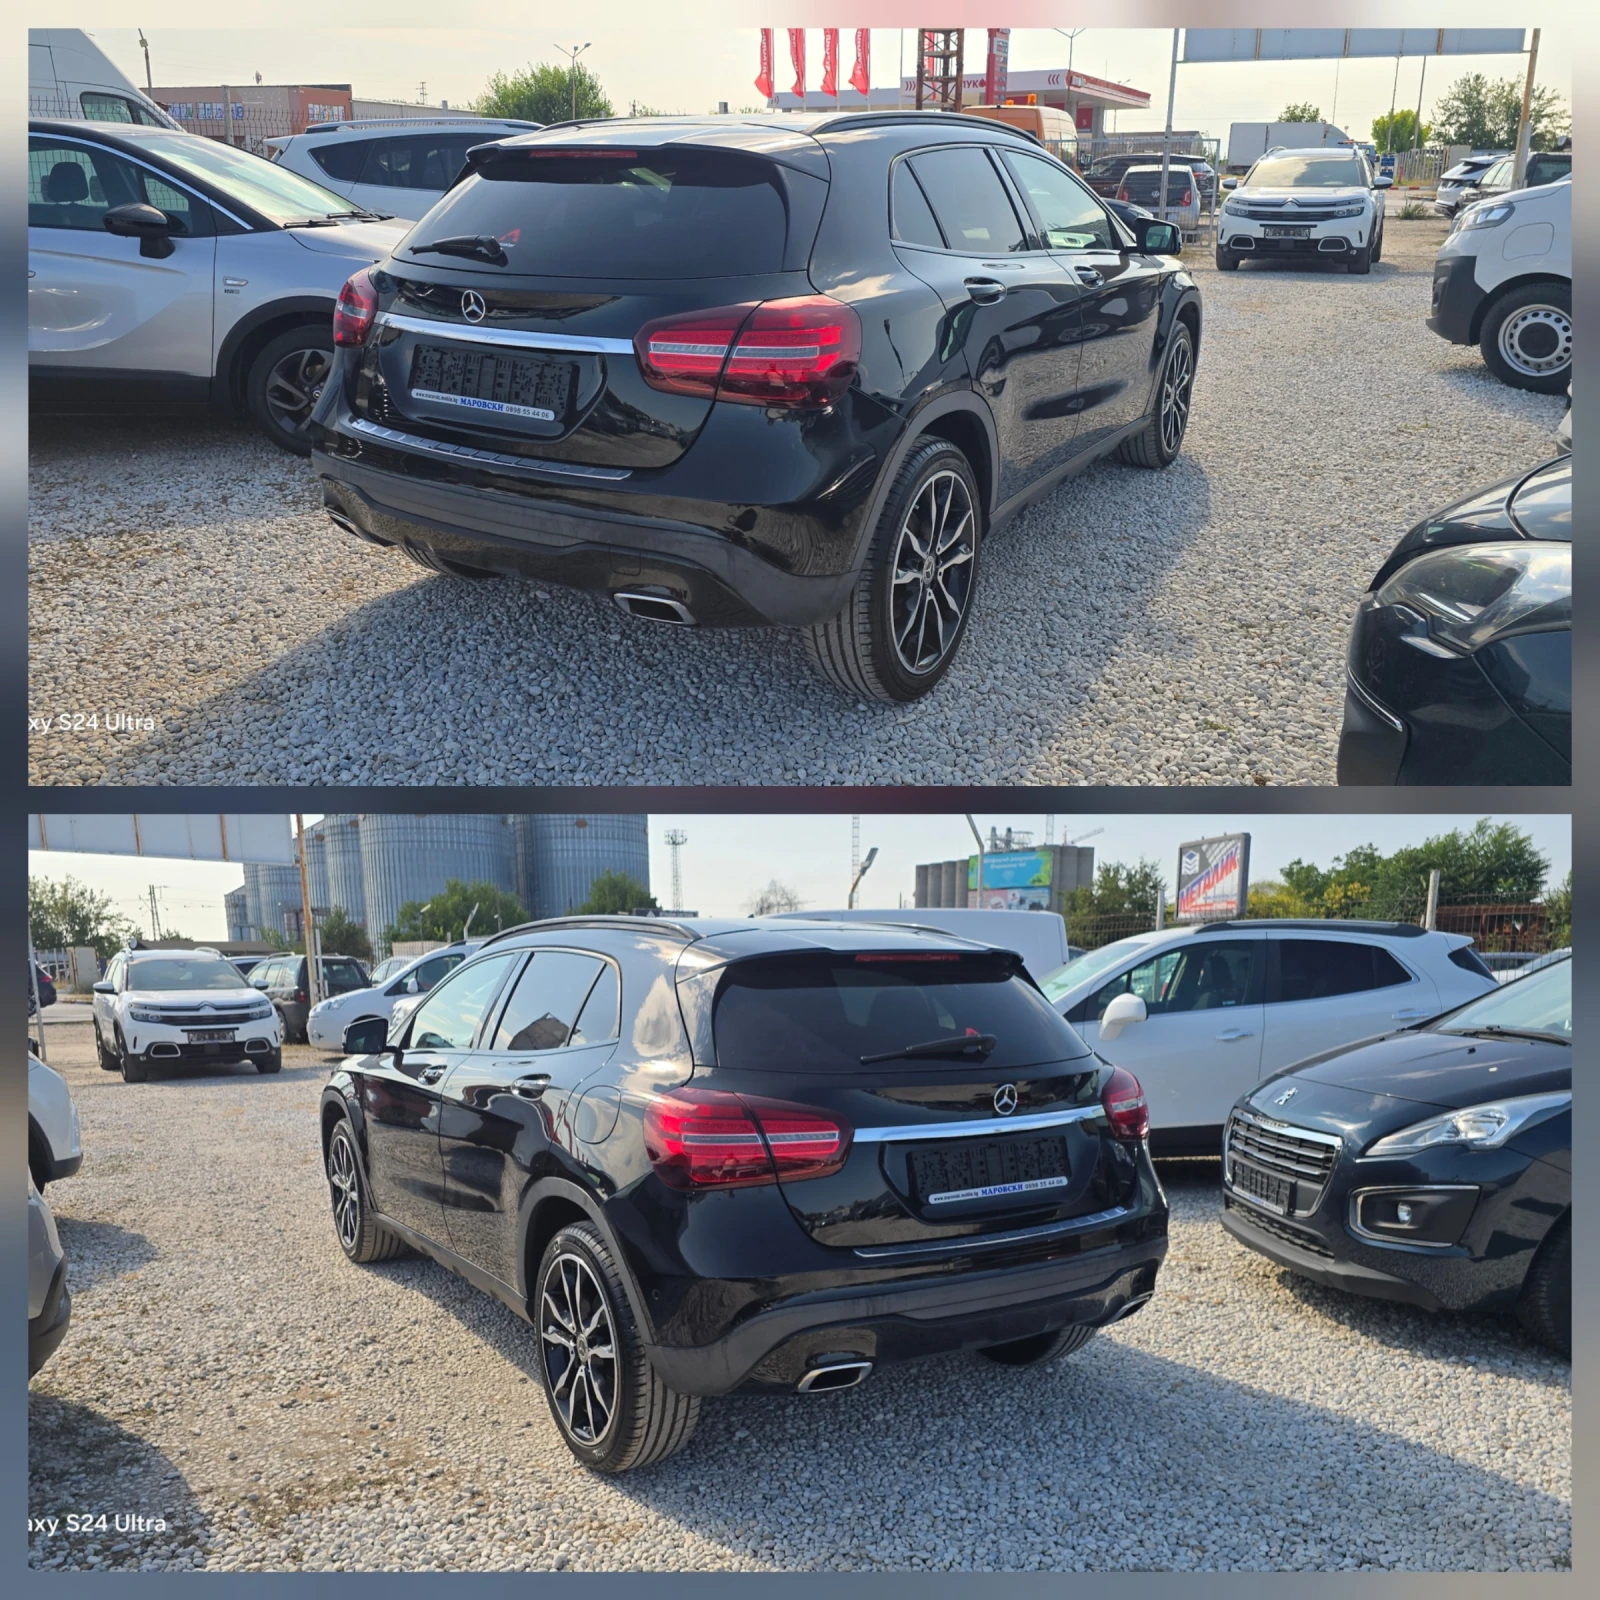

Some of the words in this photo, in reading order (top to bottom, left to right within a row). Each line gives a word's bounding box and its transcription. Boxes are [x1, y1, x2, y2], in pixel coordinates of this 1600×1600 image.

[460, 397, 504, 411] МАРОВСКИ
[505, 405, 521, 414] 0898
[981, 1183, 1023, 1195] МАРОВСКИ
[1024, 1182, 1039, 1190] 0898
